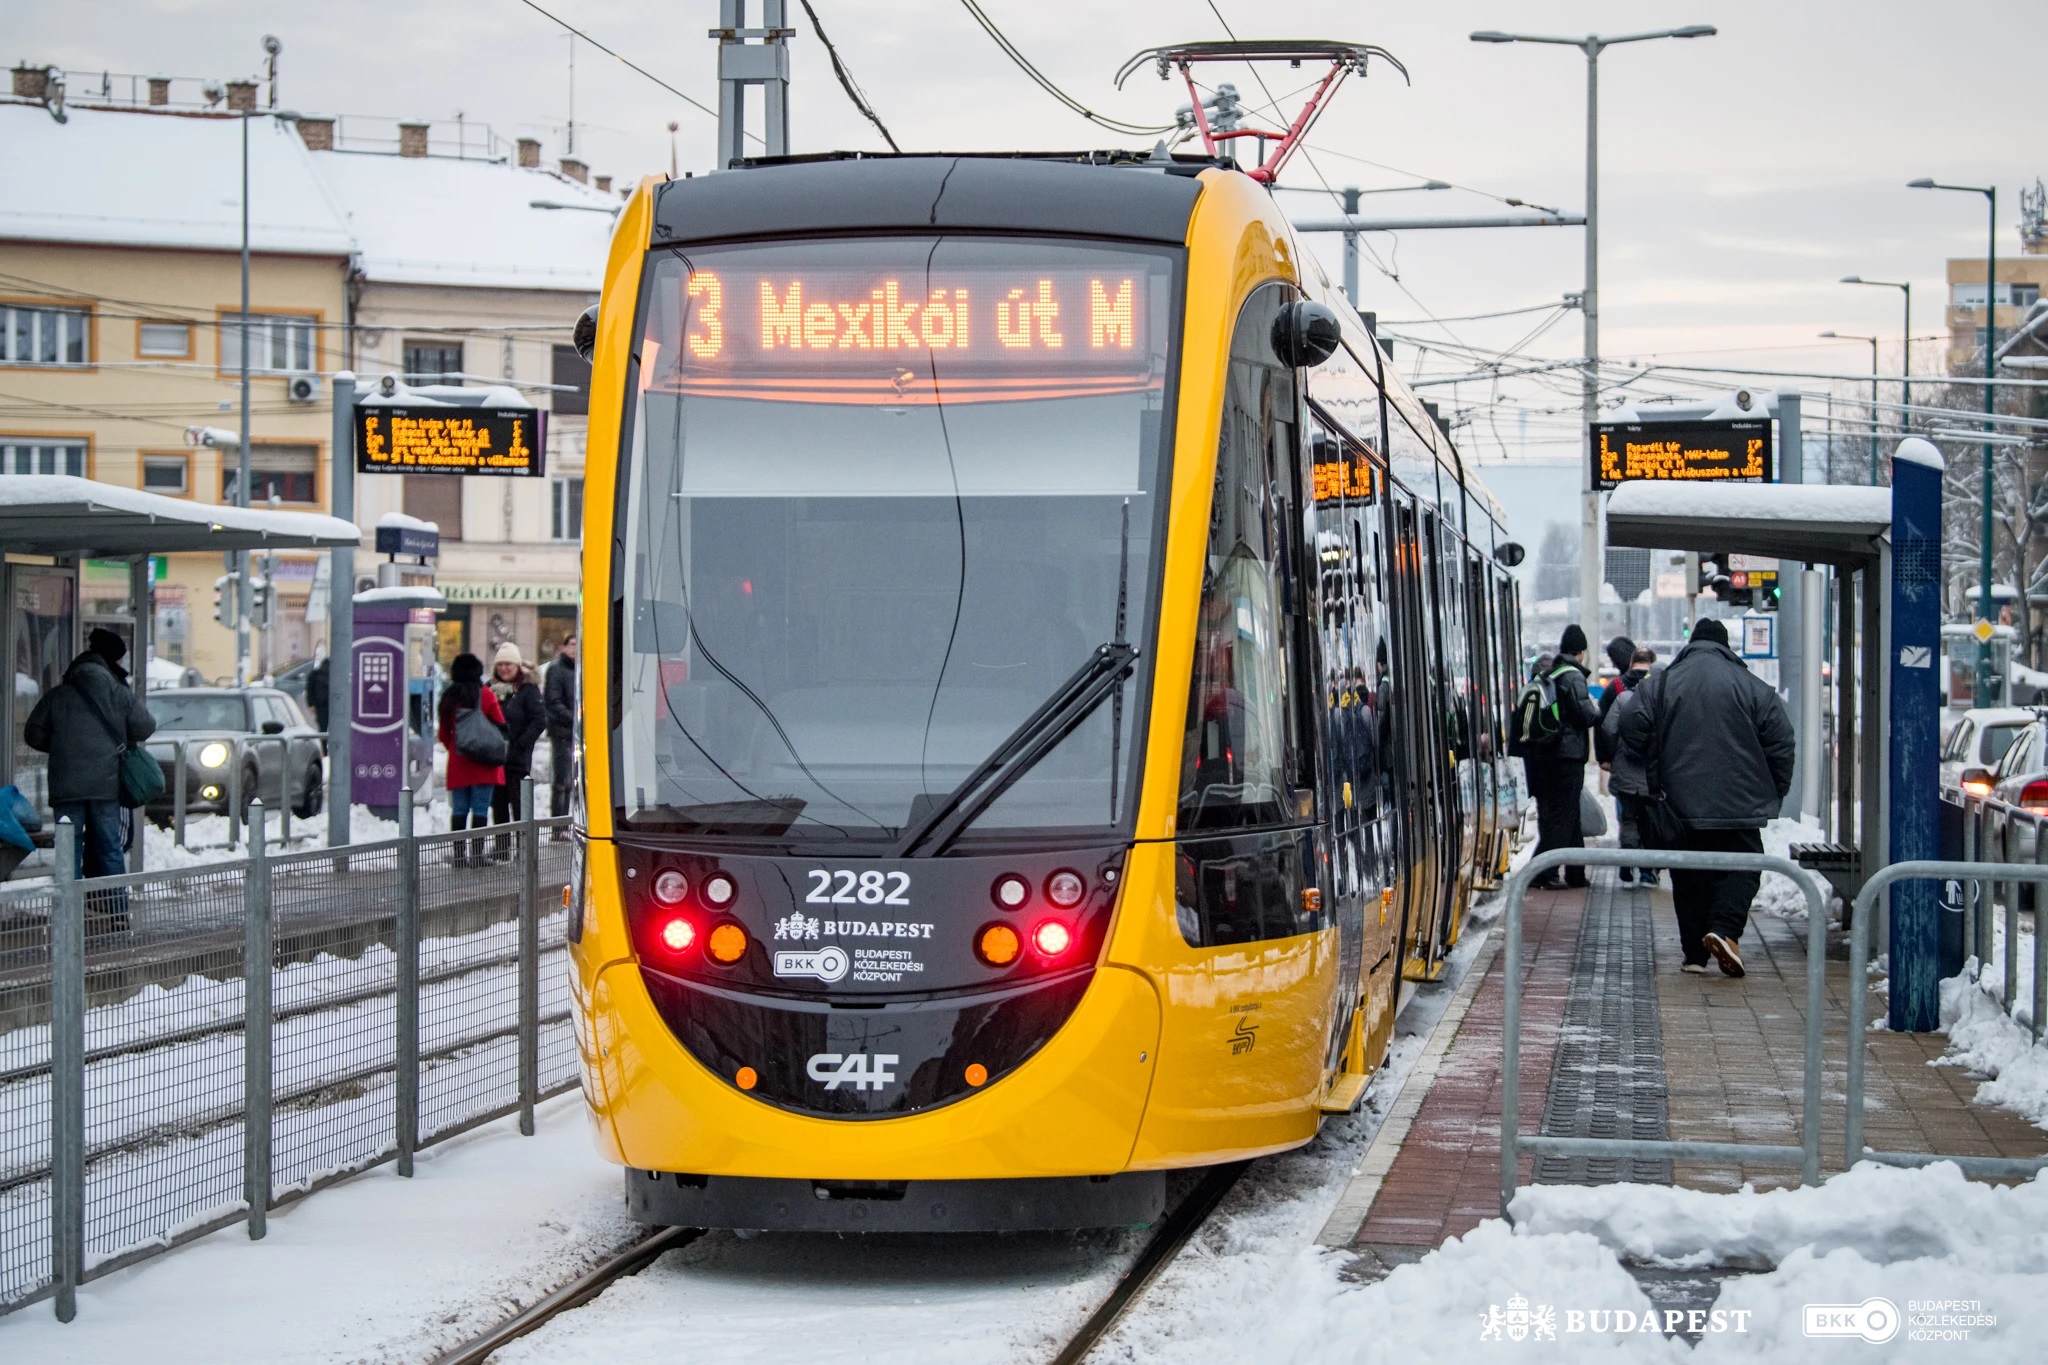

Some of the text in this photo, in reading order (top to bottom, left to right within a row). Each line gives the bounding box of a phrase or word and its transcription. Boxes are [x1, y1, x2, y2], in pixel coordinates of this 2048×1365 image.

[689, 273, 1133, 357] 3 Mexikói út M
[806, 869, 911, 905] 2282
[823, 920, 935, 938] BUDAPEST
[854, 949, 912, 960] BUDAPESTI
[784, 958, 815, 969] BKK
[854, 959, 924, 972] KÖZLEKEDÉSI
[853, 971, 902, 982] KÖZPONT
[806, 1053, 899, 1091] CAF
